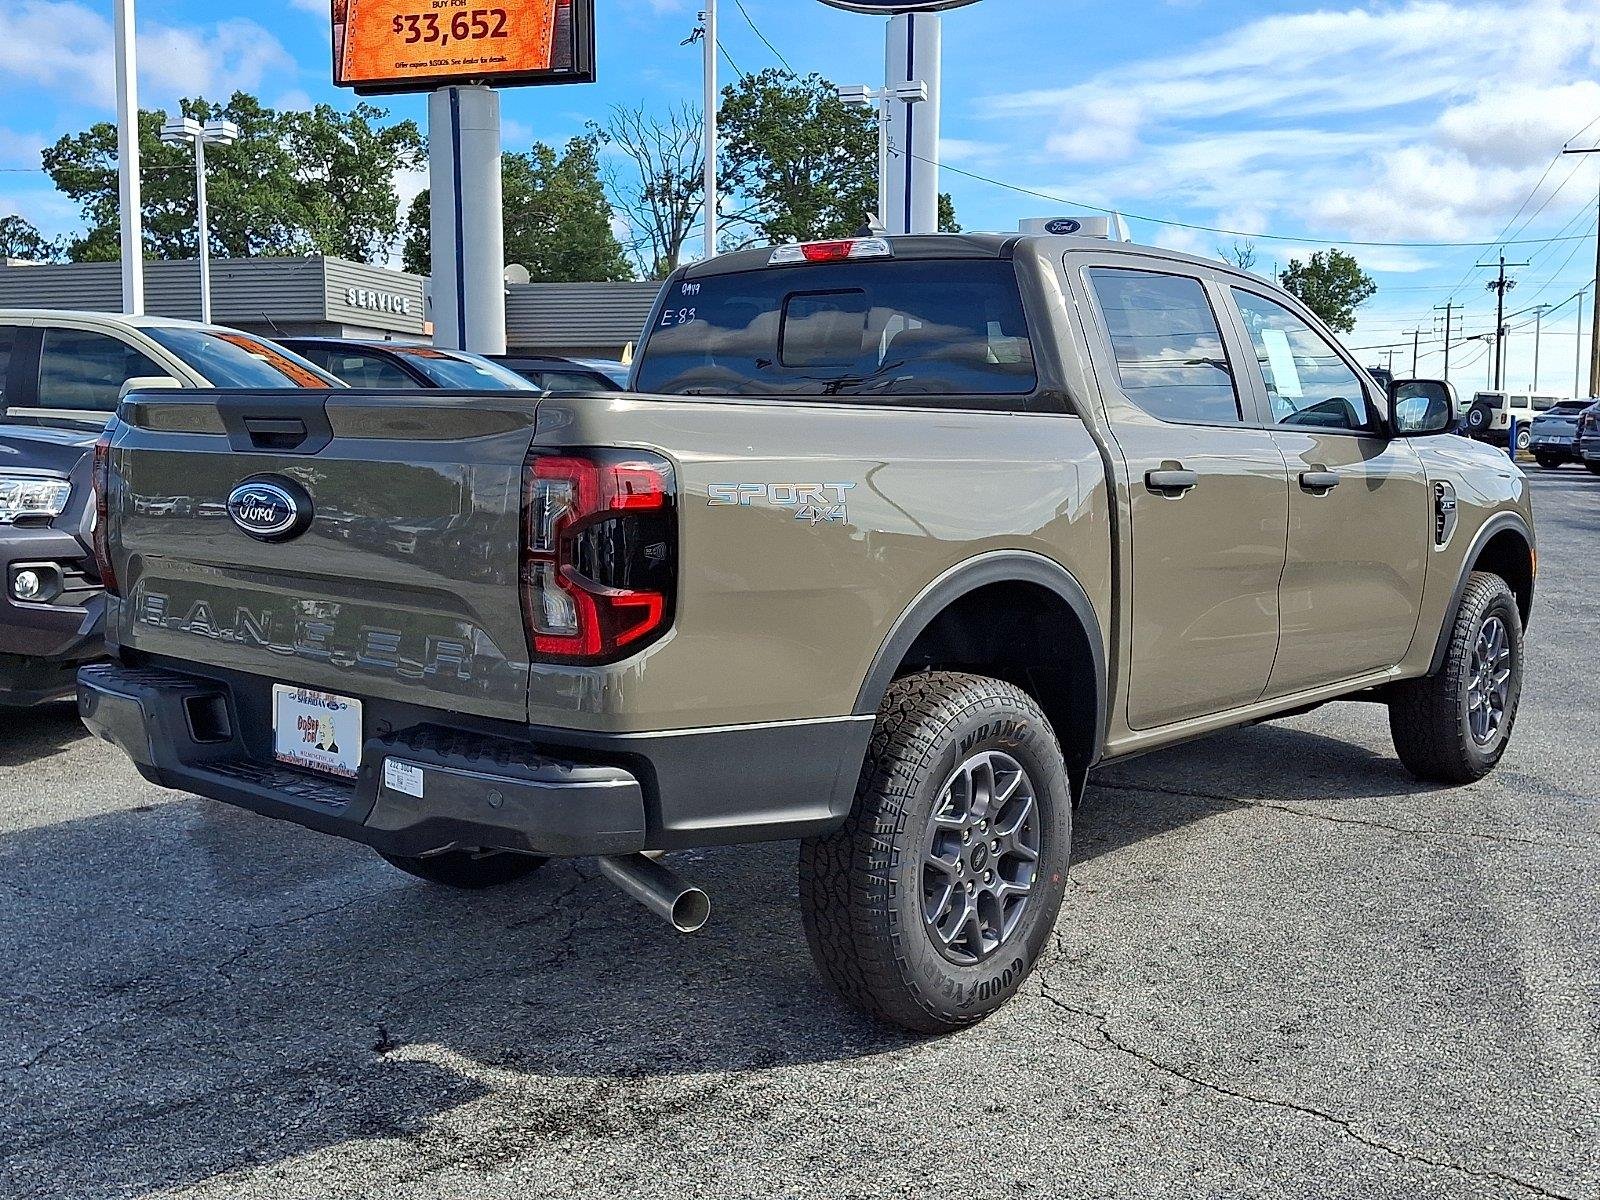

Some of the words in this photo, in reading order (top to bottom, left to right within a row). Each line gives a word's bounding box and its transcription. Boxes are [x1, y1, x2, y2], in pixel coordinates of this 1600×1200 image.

[432, 0, 448, 8] BUY
[393, 9, 508, 46] $33,652
[346, 287, 410, 314] SERVICE
[660, 307, 696, 326] E-83
[707, 483, 858, 506] SPORT
[239, 493, 277, 522] Ford
